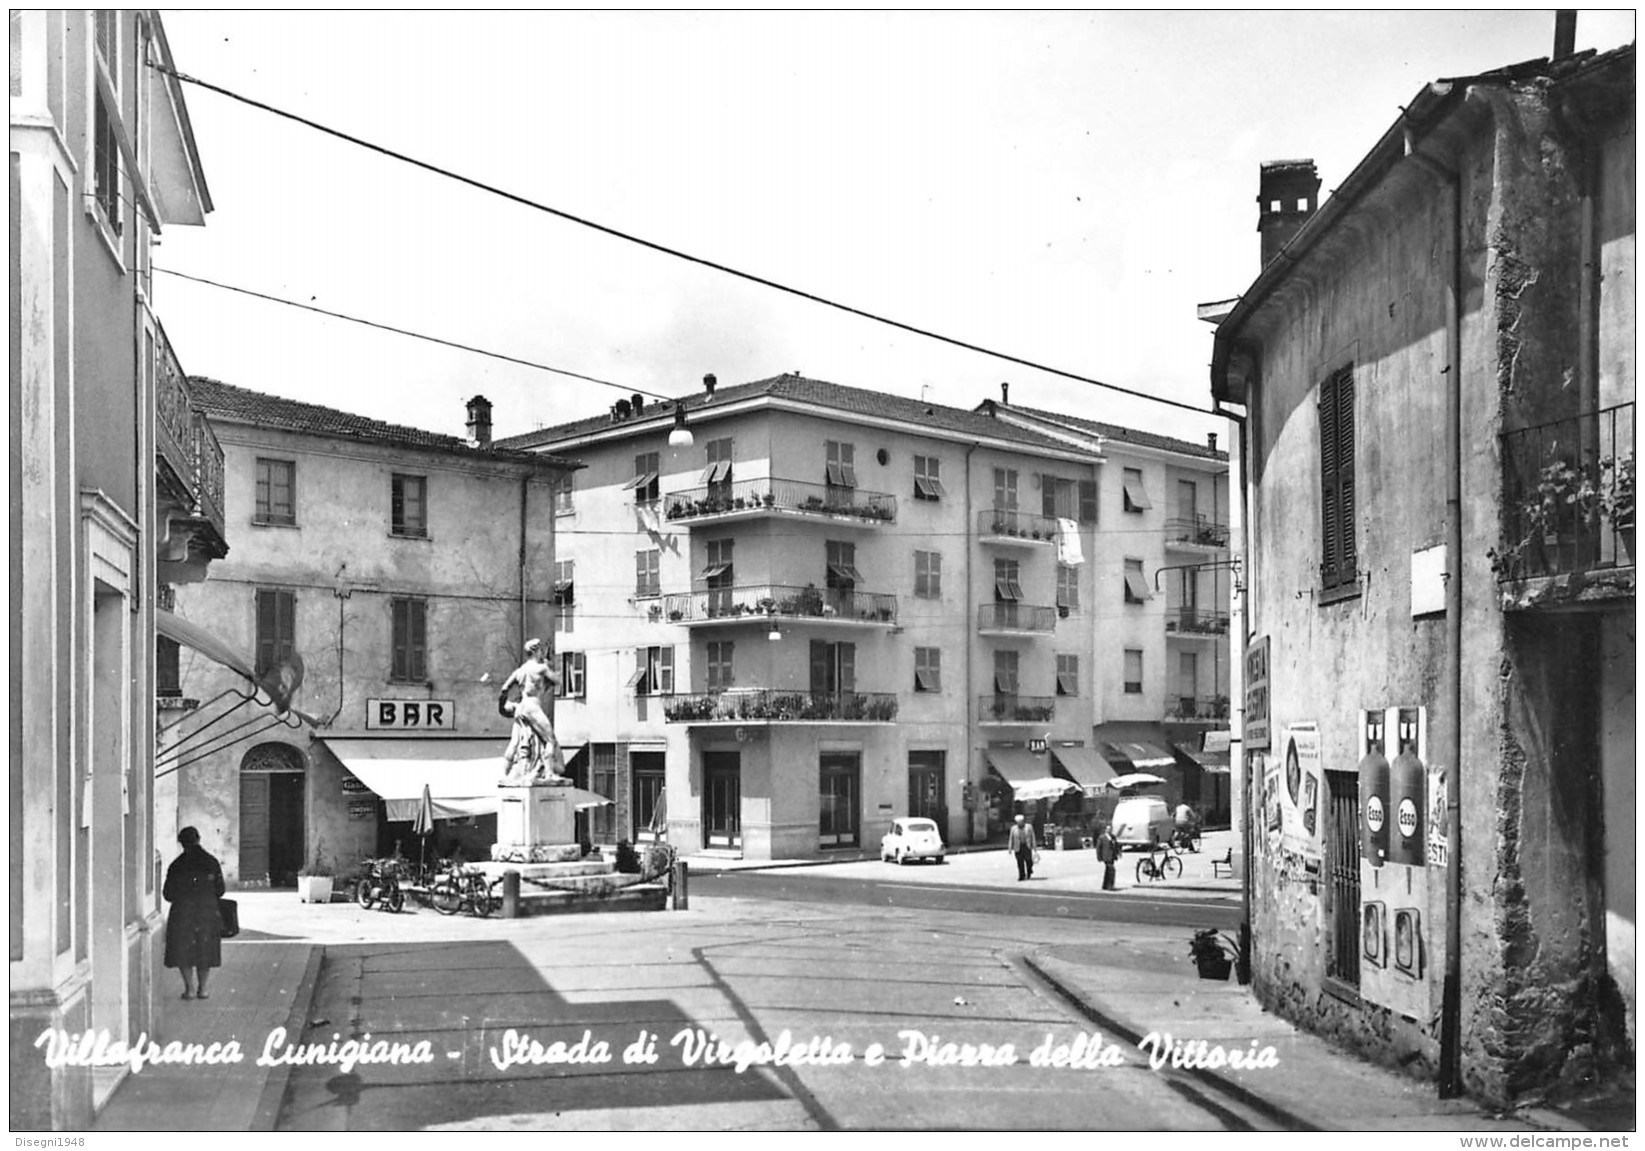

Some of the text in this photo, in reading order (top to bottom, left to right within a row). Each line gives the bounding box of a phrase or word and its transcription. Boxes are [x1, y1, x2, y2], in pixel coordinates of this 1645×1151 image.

[379, 702, 444, 726] BAR
[1031, 740, 1046, 752] BAR
[1368, 805, 1382, 822] Esso
[1400, 808, 1415, 827] Esso
